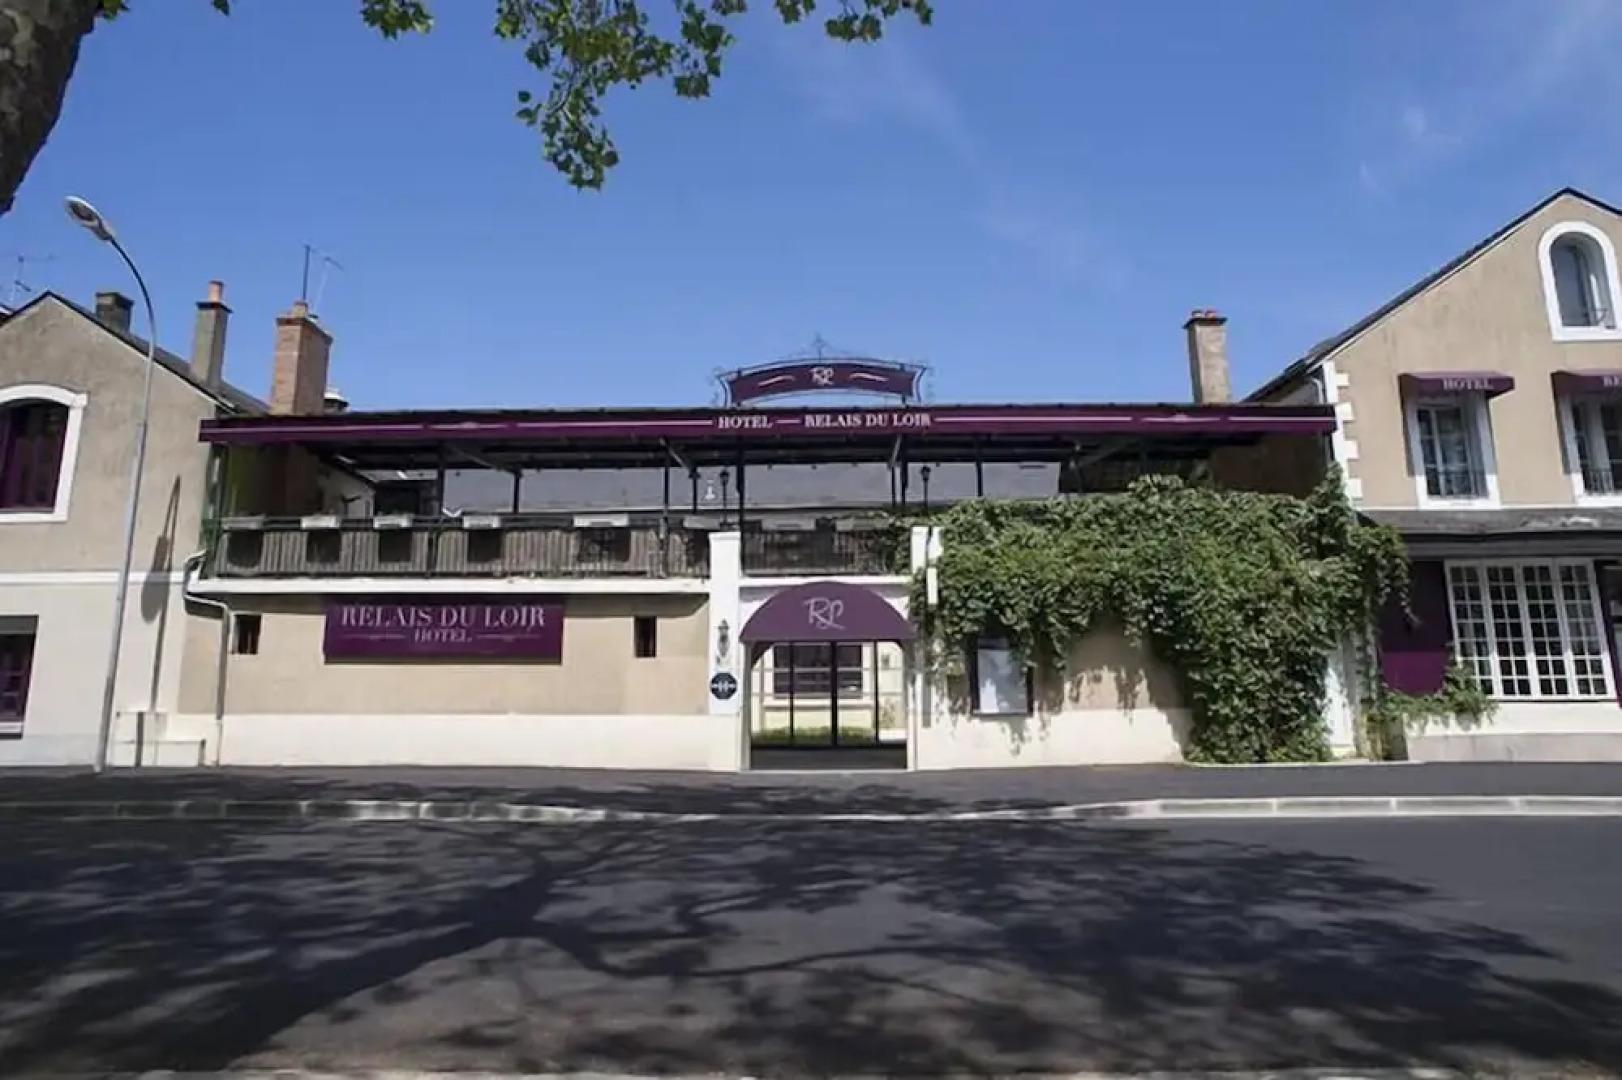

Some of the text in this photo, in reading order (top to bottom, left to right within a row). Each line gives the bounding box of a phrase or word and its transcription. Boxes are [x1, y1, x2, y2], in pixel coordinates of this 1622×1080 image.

[1442, 378, 1495, 390] HOTEL
[718, 412, 932, 429] HOTEL RELAIS DU LOIR
[341, 605, 546, 631] RELAIS DU LOIR
[414, 628, 473, 643] HOTEL
